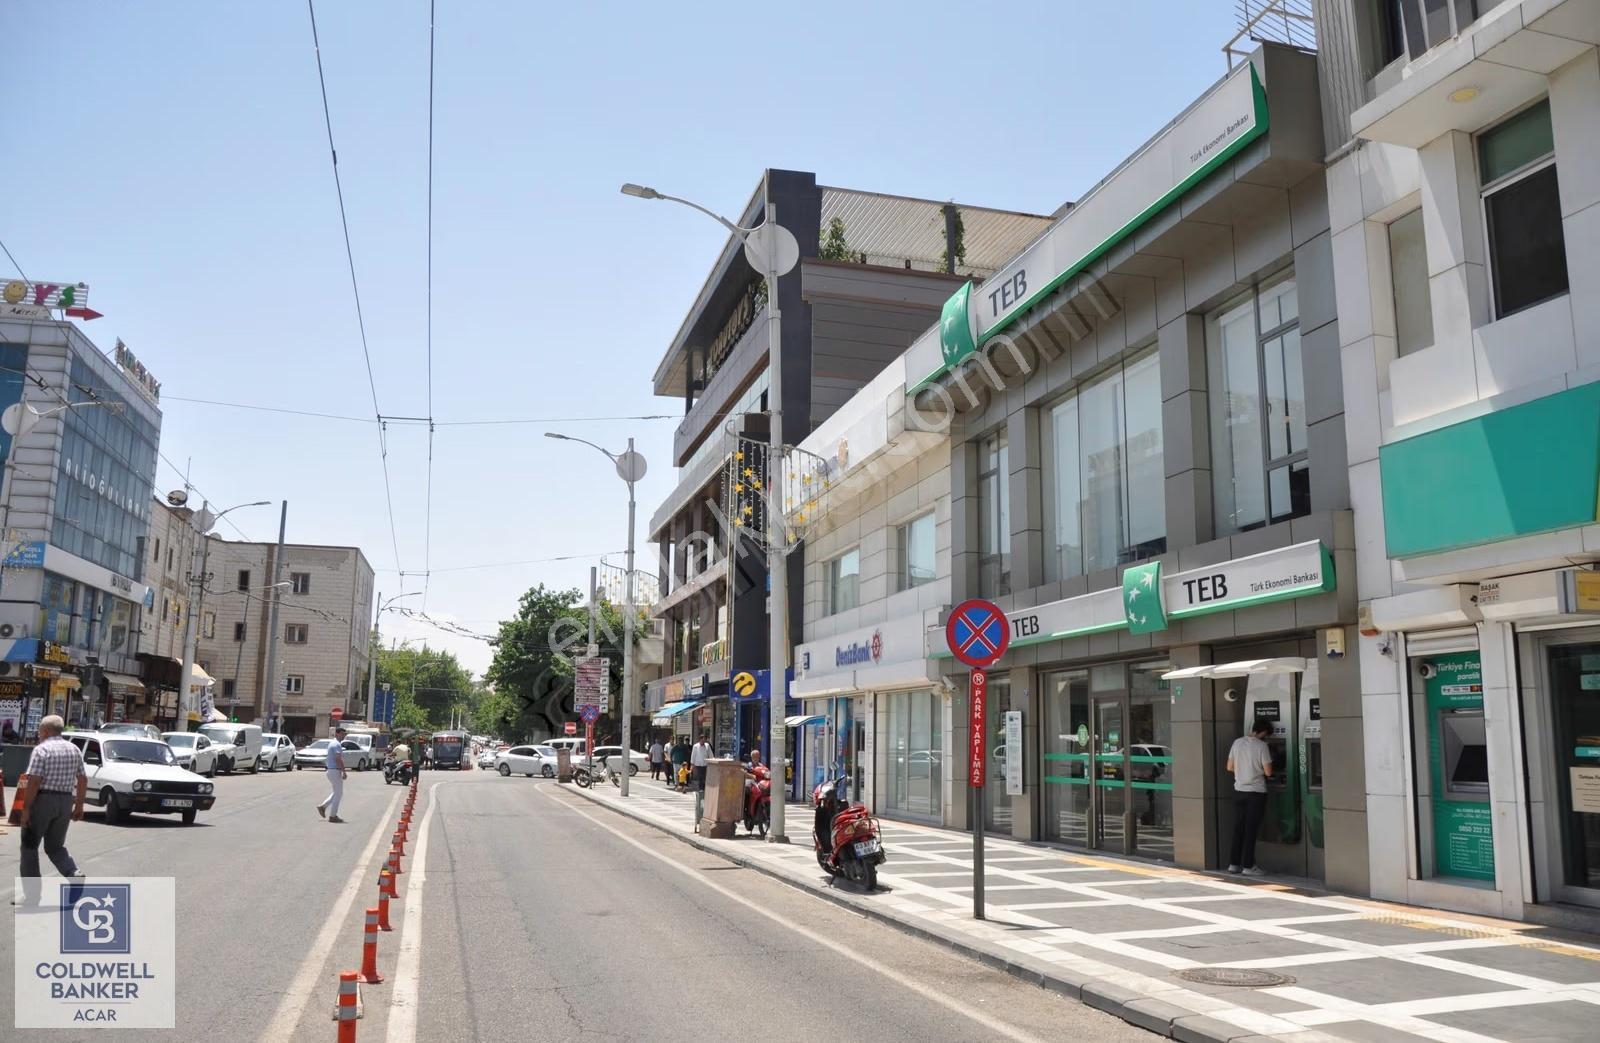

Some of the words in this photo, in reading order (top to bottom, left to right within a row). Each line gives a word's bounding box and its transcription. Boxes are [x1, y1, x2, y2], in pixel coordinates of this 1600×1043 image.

[1190, 151, 1202, 163] Türk
[1203, 130, 1227, 153] Ekonomi
[1227, 114, 1249, 135] Bankası
[989, 269, 1027, 317] TEB
[1183, 574, 1228, 604] TEB
[1250, 581, 1264, 593] Türk
[1265, 577, 1292, 591] Ekonomi
[1293, 572, 1319, 587] Bankası
[1012, 615, 1039, 638] TEB
[836, 641, 870, 667] DenizBank
[1437, 662, 1463, 672] Türkiye
[974, 724, 982, 783] YAPILMAZ
